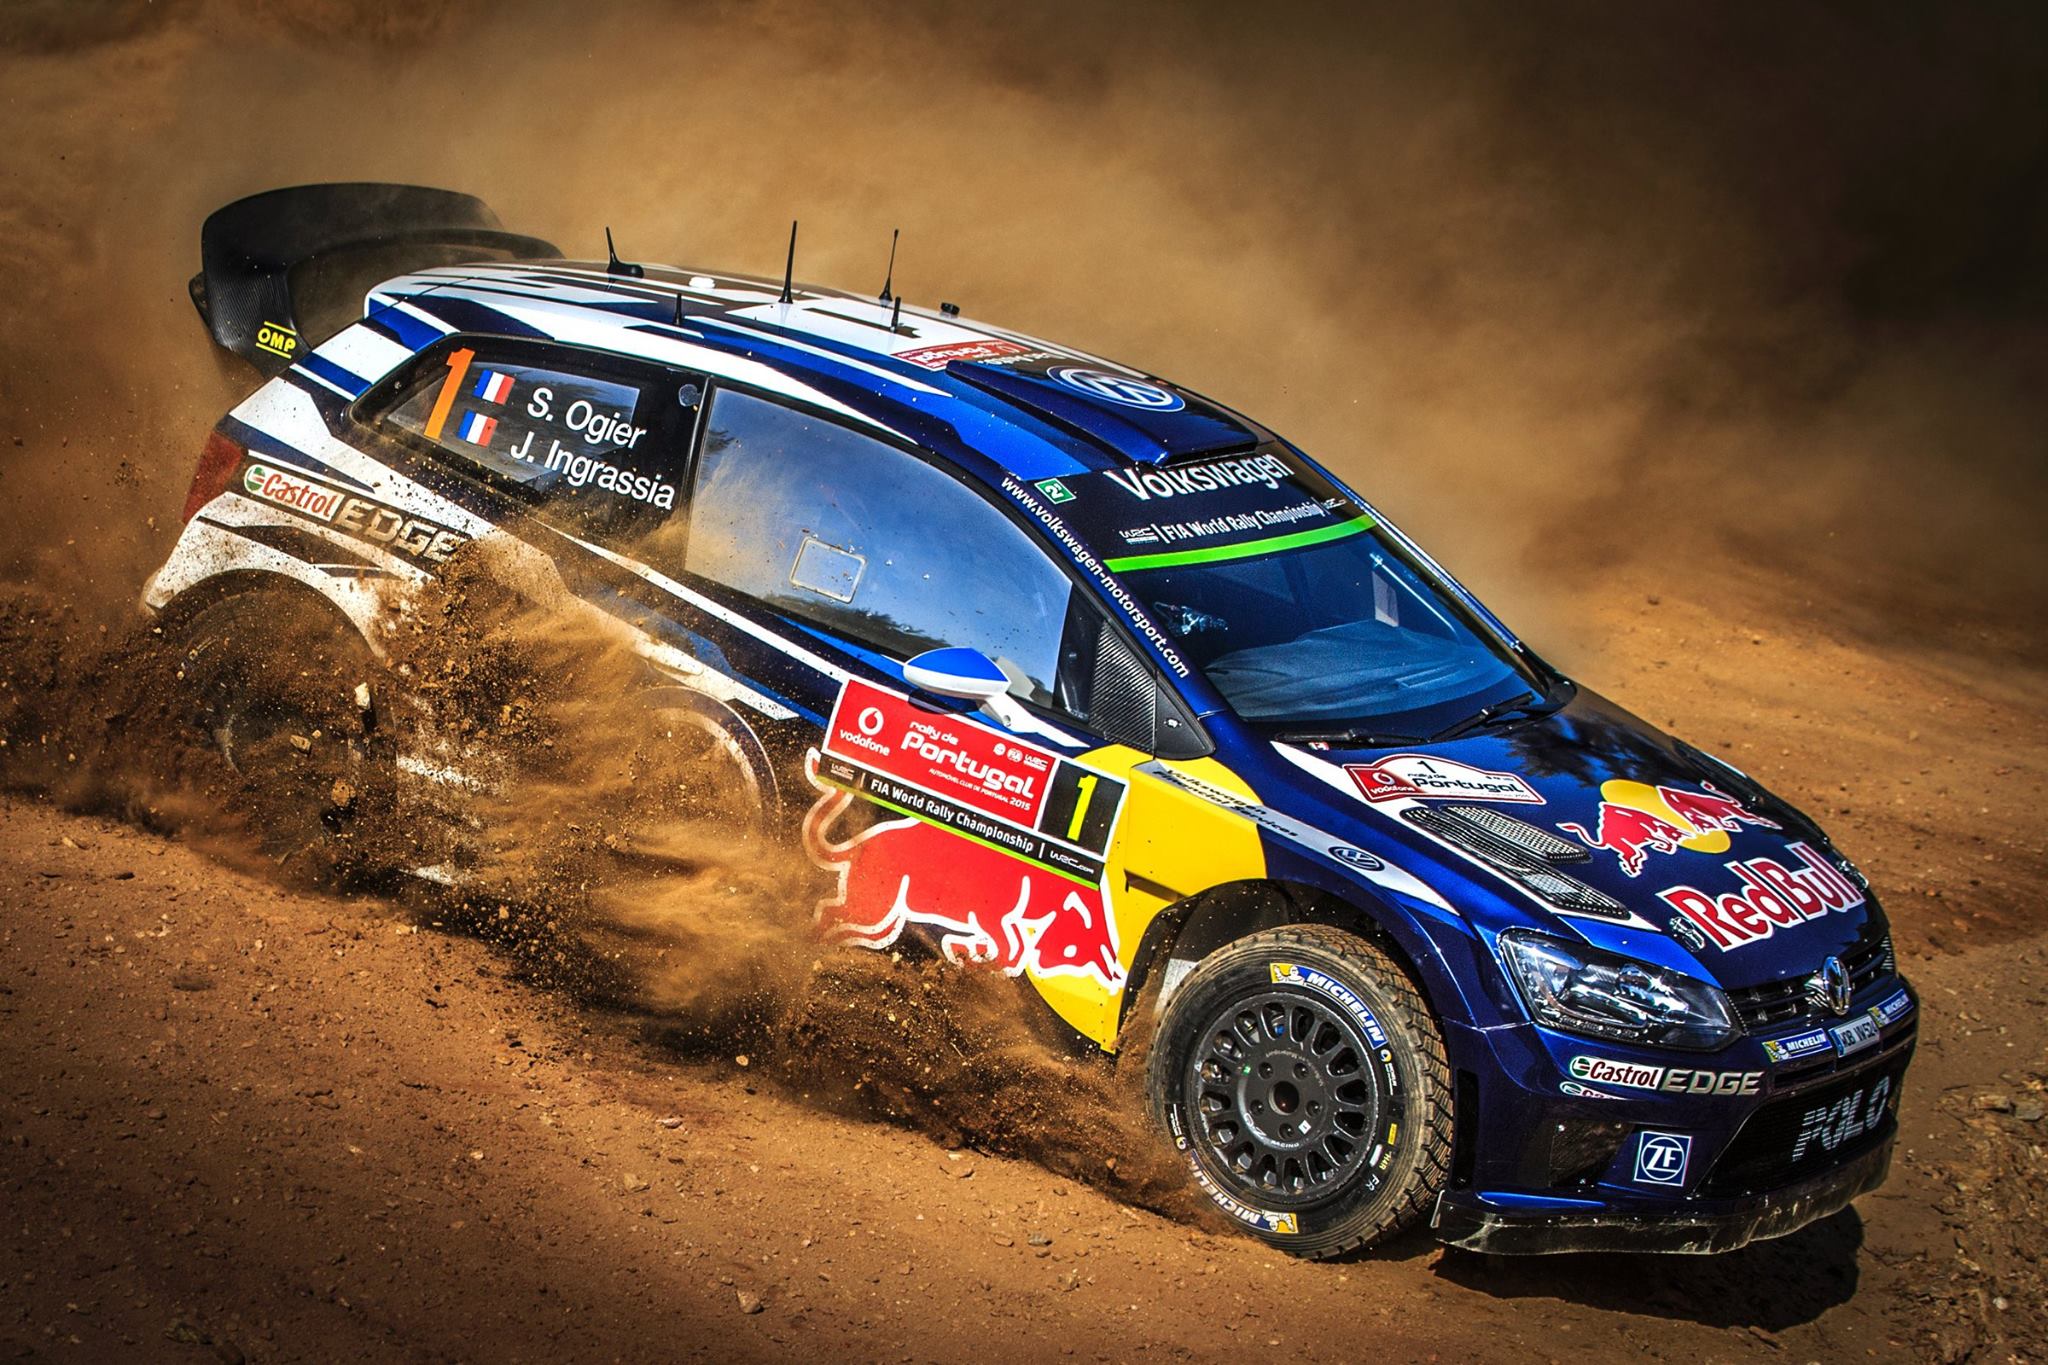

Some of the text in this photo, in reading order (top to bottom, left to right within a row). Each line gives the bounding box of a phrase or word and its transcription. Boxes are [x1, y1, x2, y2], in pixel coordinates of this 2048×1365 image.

[257, 327, 296, 353] OMP
[423, 347, 476, 441] 1
[527, 387, 647, 449] S. Ogier
[510, 431, 675, 510] J. Ingrassia
[1103, 453, 1295, 501] Volkswagen
[261, 472, 468, 565] Castrol EDGE
[1161, 524, 1193, 541] FIA
[1188, 518, 1231, 537] World
[1226, 511, 1262, 530] Rally
[1255, 501, 1324, 525] Championship
[1001, 477, 1189, 678] www.volkswagen-motorsport.com
[840, 729, 890, 756] vodafone
[909, 721, 959, 745] rally de
[901, 731, 1034, 799] Portugal
[1412, 777, 1524, 793] Portugal
[1416, 760, 1437, 774] 1
[870, 778, 889, 795] FIA
[892, 785, 924, 809] World
[925, 799, 954, 822] Rally
[956, 812, 1034, 853] Championship
[1009, 796, 1031, 811] 2015
[1066, 774, 1098, 841] 1
[1307, 972, 1385, 1042] MICHELIN
[1786, 1033, 1827, 1051] MICHELIN
[1589, 1061, 1659, 1088] Castrol
[1659, 1068, 1764, 1095] EDGE
[1792, 1076, 1890, 1161] POLO
[1645, 1144, 1684, 1174] ZF
